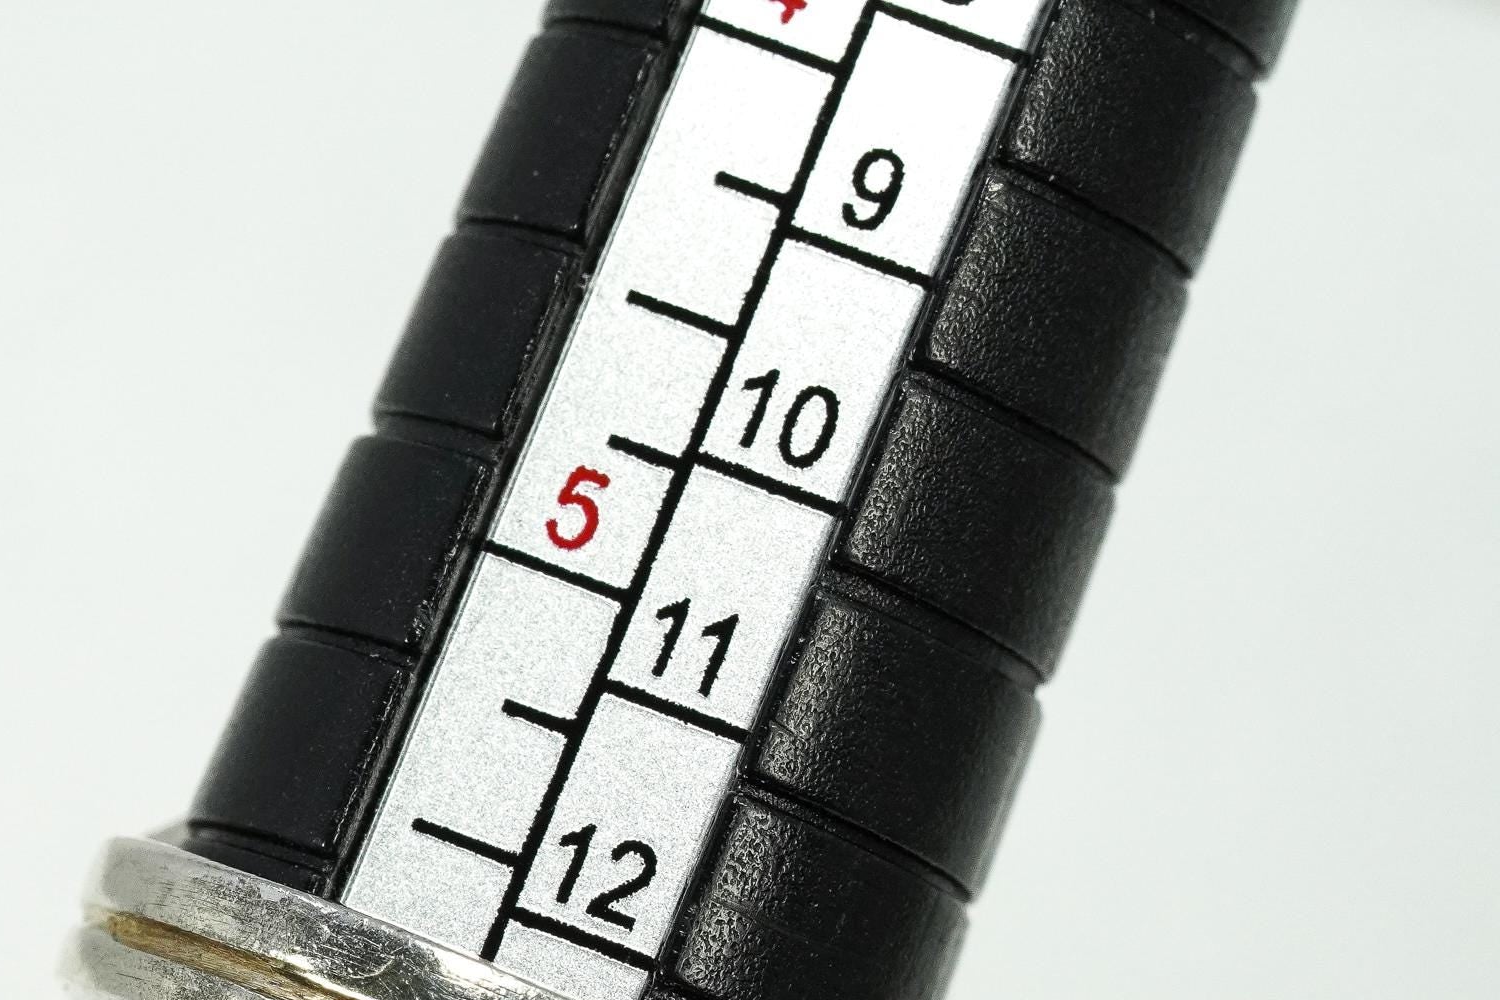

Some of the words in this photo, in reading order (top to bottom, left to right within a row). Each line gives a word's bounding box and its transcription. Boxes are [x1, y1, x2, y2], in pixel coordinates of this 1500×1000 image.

[841, 148, 905, 231] 9
[739, 368, 841, 470] 10
[545, 465, 611, 551] 5
[652, 597, 740, 698] 11
[556, 823, 658, 933] 12
